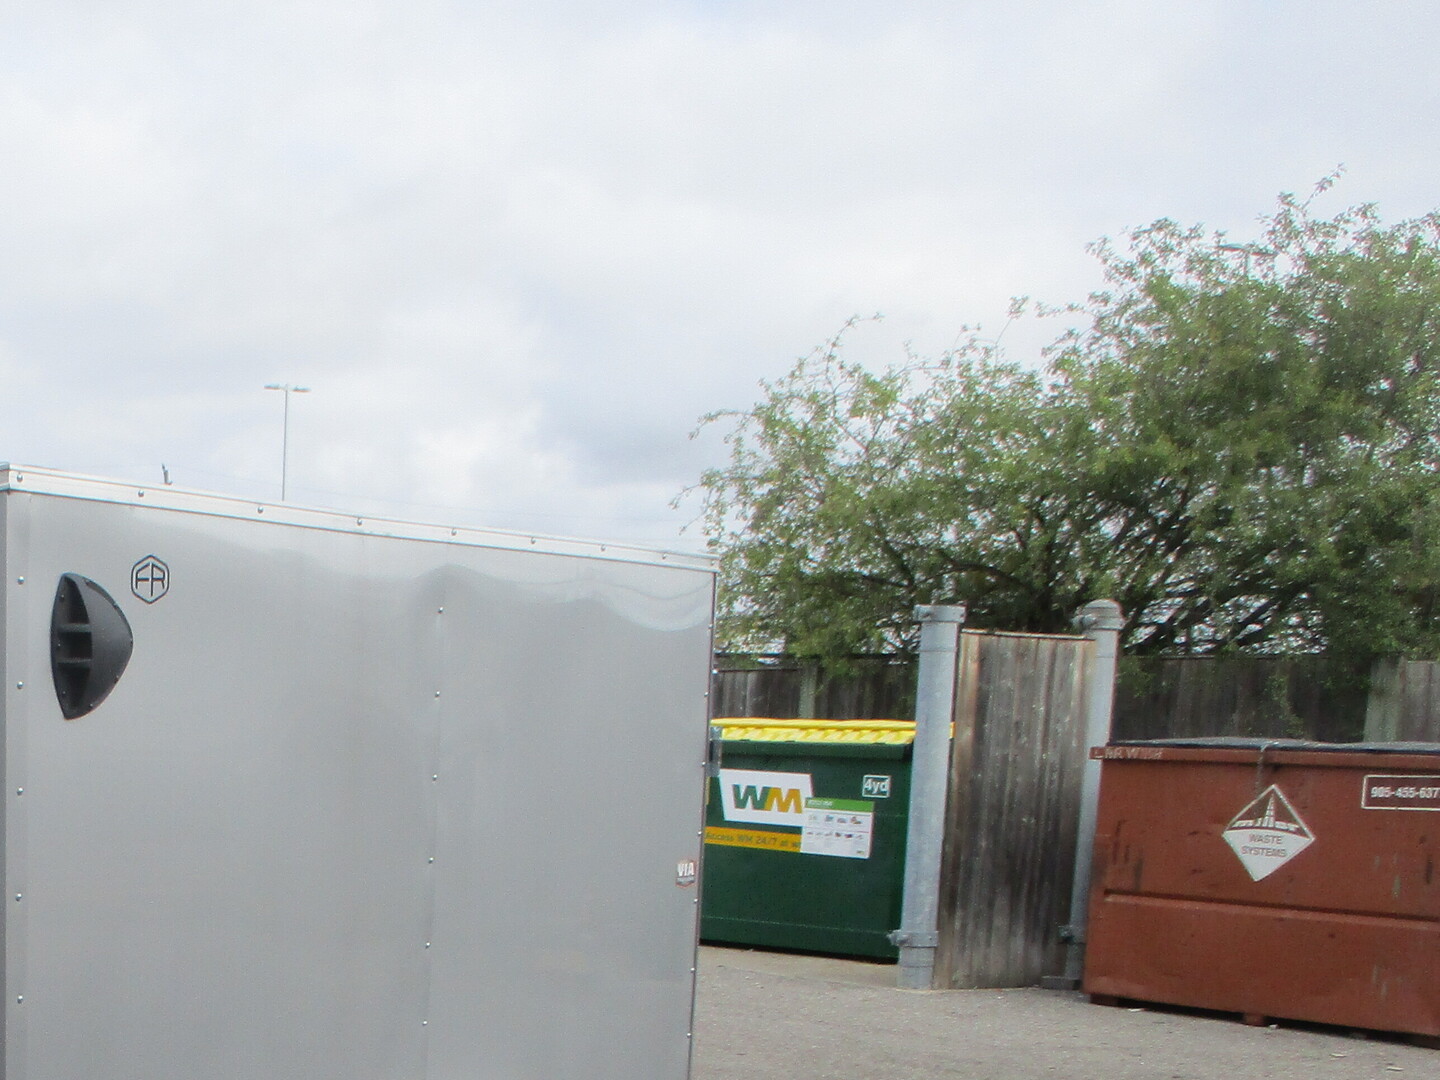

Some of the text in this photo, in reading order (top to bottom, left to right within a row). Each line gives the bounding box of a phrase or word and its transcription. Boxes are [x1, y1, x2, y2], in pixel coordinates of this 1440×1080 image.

[864, 779, 889, 795] 4yd
[1370, 786, 1440, 798] 905-455-637
[732, 784, 803, 814] WM
[1248, 834, 1284, 845] WASTE
[1241, 845, 1287, 858] SYSTEMS
